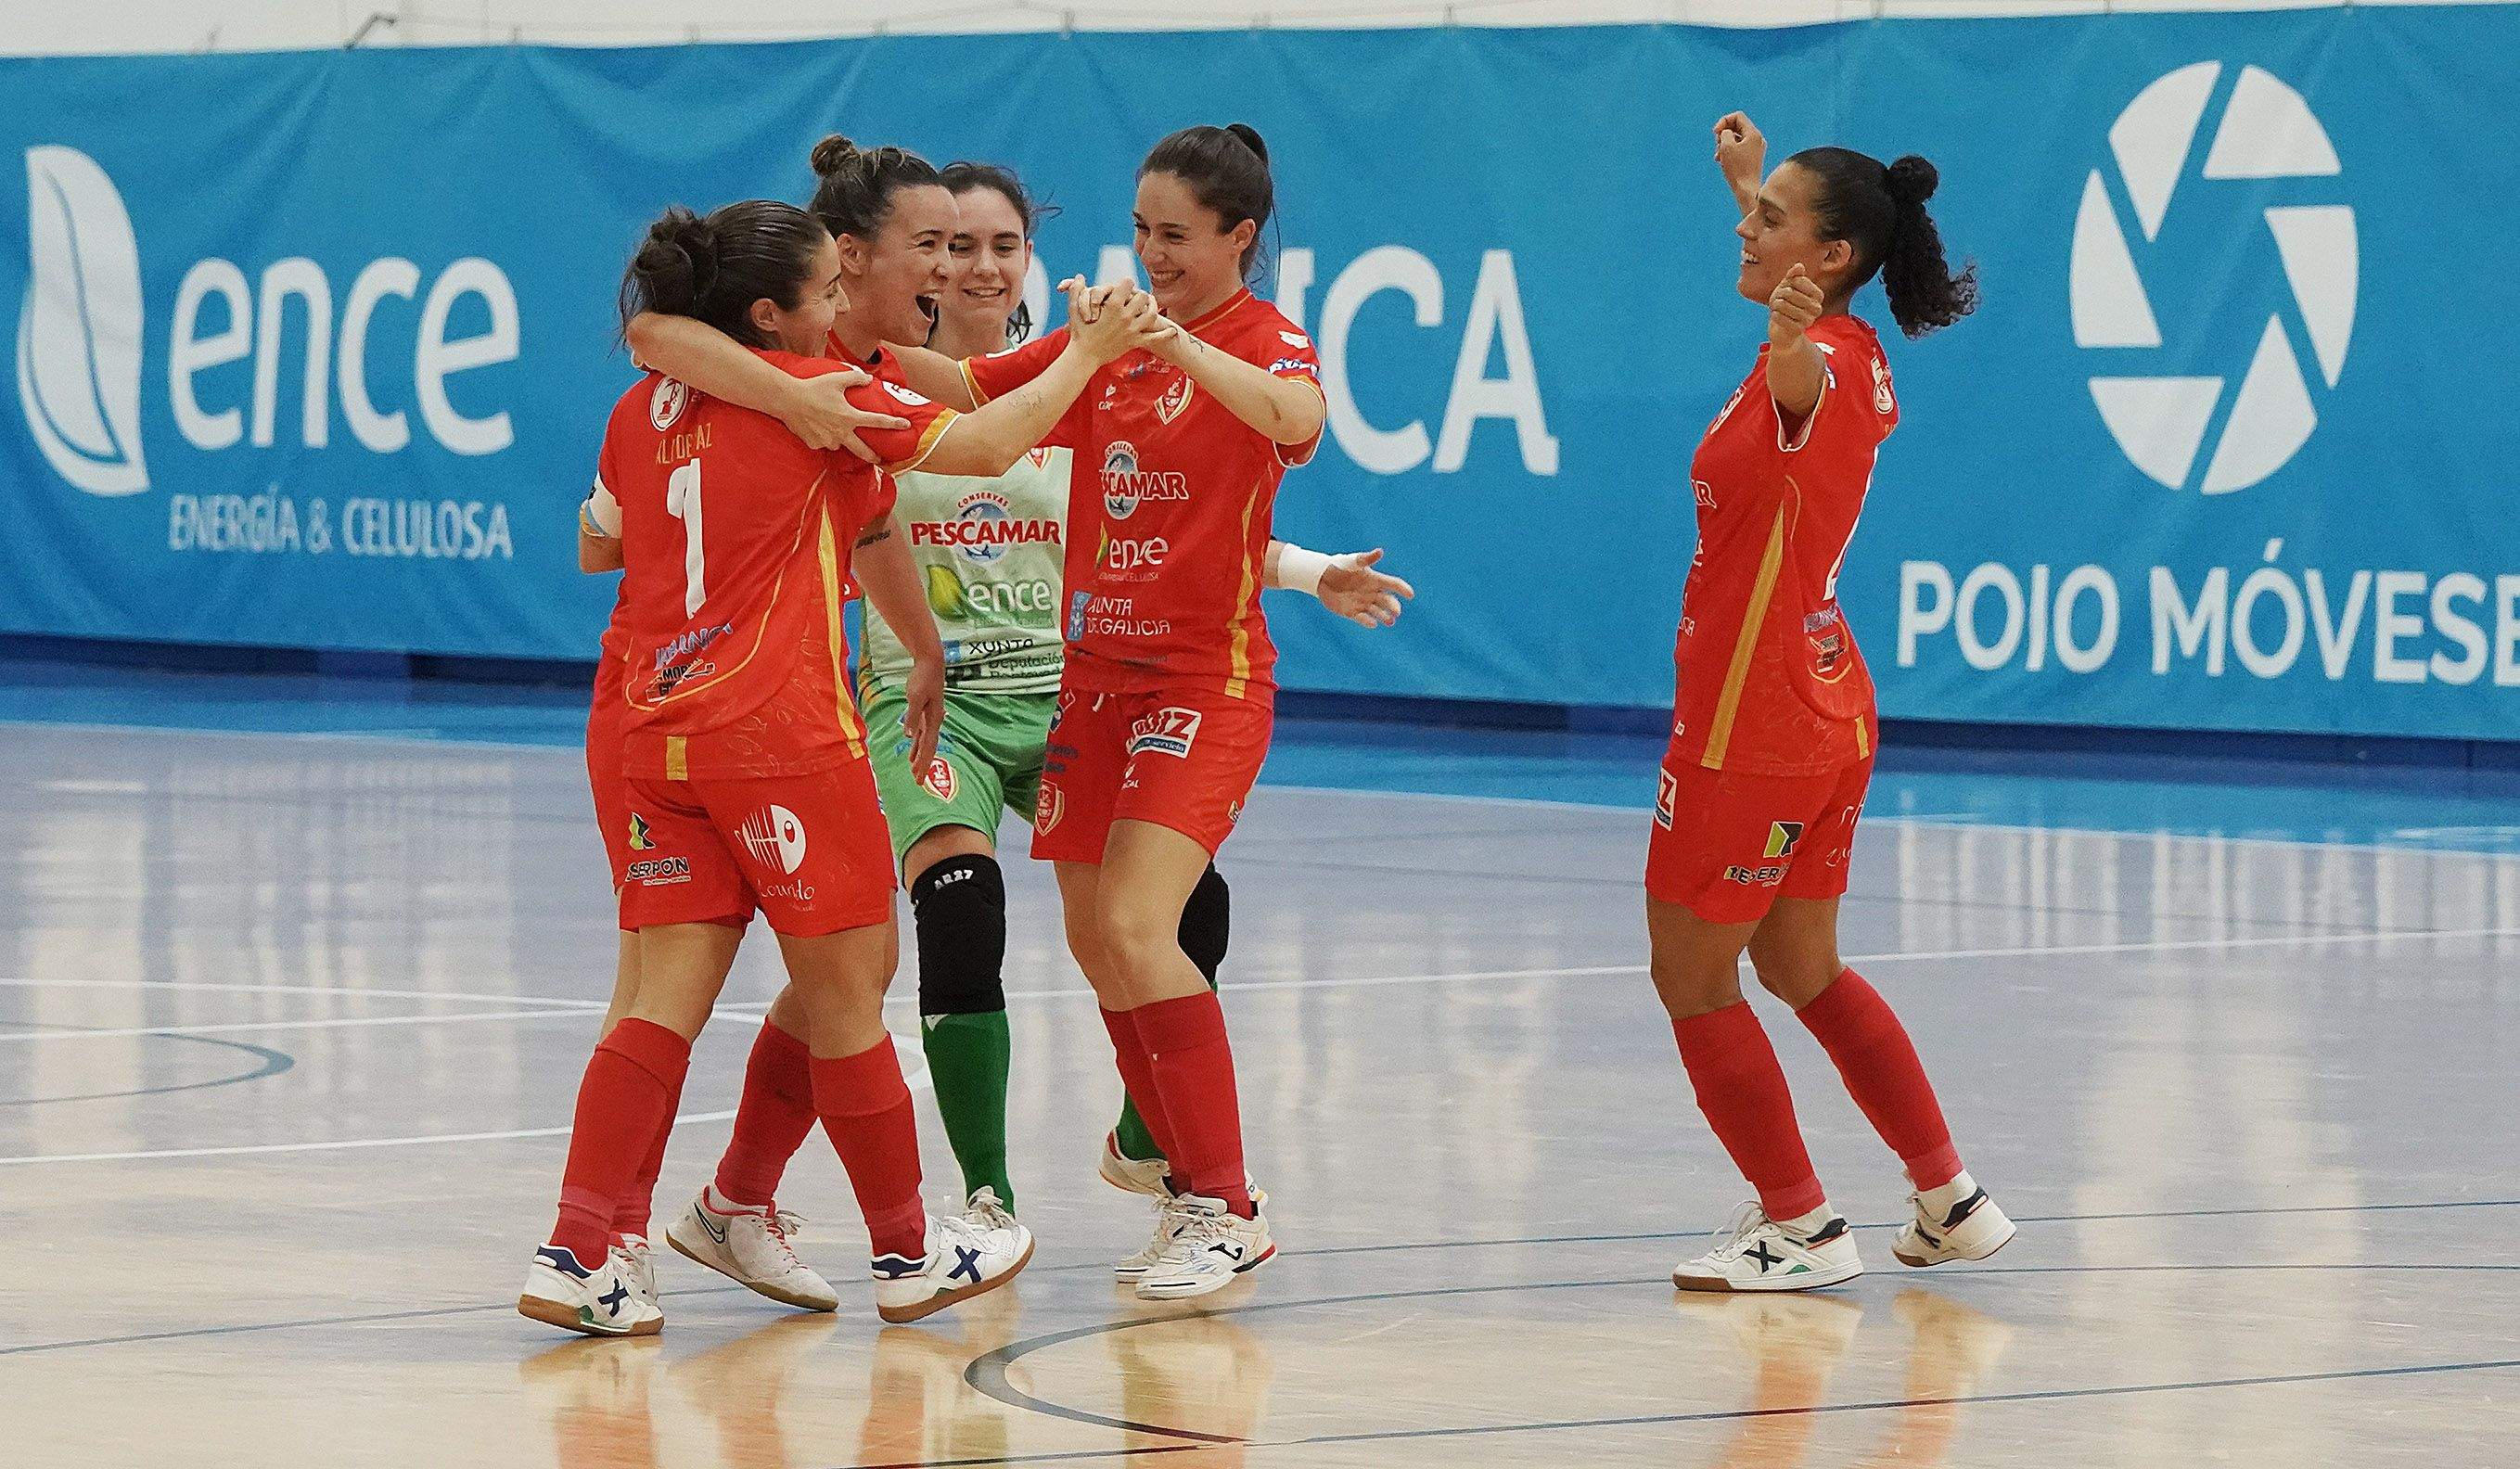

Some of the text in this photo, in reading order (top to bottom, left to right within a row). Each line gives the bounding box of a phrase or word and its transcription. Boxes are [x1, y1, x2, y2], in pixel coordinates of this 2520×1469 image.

[169, 257, 520, 455] ence
[957, 492, 1009, 509] CONSERVAS
[169, 482, 513, 560] ENERGÍA & CELULOSA
[909, 519, 1062, 546] PESCAMAR
[967, 581, 1053, 613] ence
[1100, 618, 1170, 636] GALICIA
[1898, 560, 2119, 674] POIO
